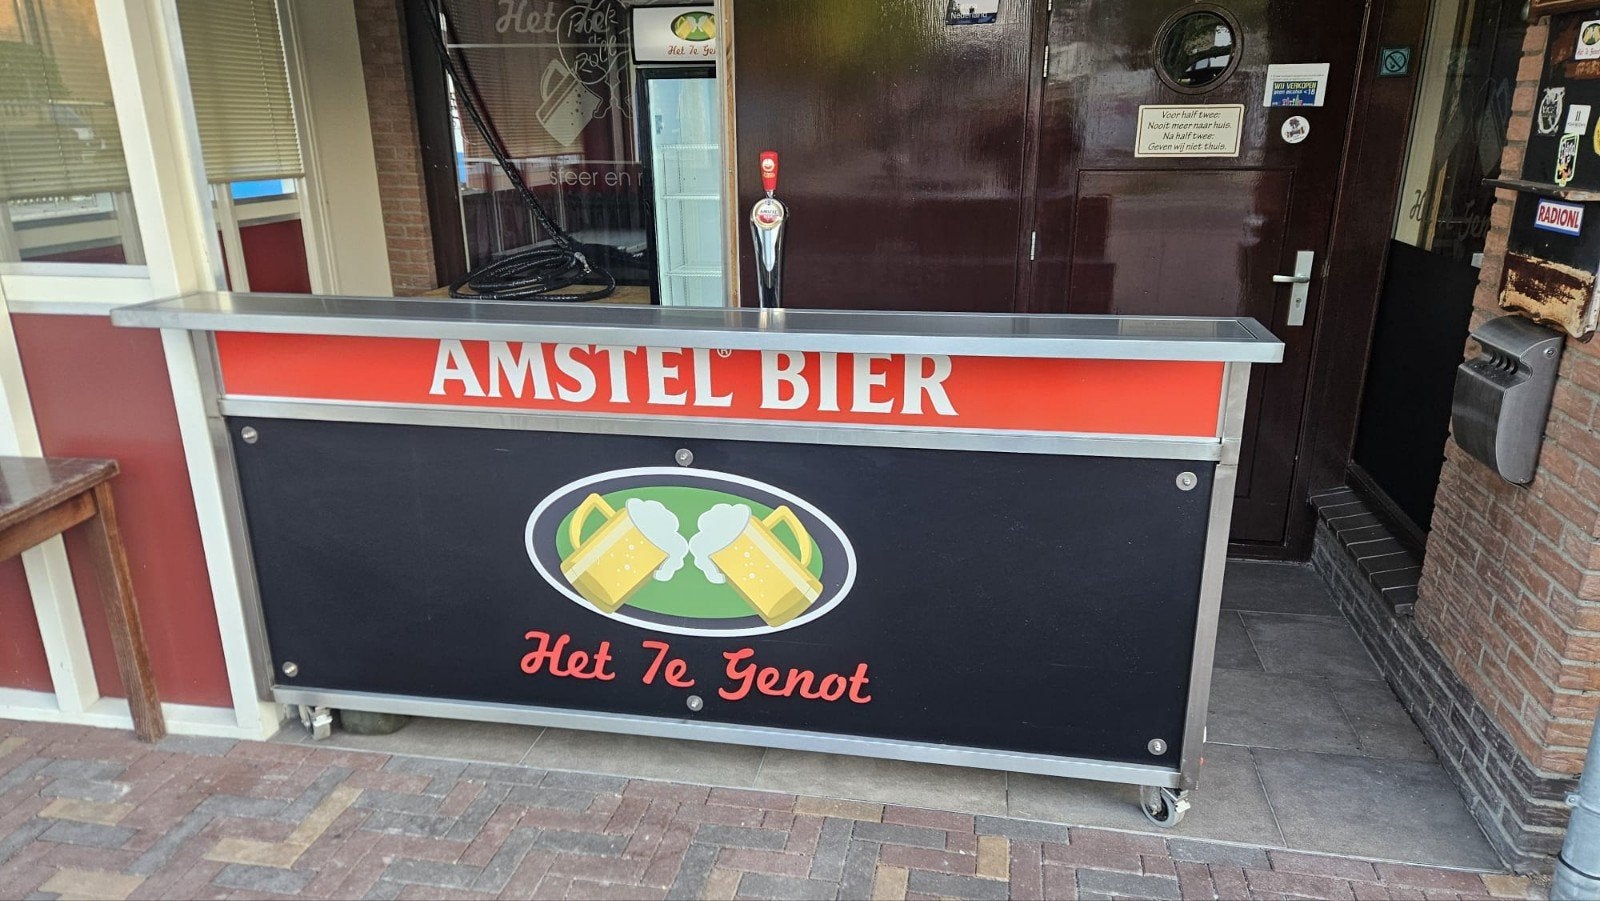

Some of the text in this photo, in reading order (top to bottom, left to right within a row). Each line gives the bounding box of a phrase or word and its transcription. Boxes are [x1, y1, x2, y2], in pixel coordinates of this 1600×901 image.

[495, 0, 558, 33] Het
[667, 45, 685, 55] Het
[1162, 111, 1180, 119] Voor
[1181, 110, 1199, 119] half
[1213, 121, 1232, 129] huis.
[1162, 132, 1174, 140] Na
[1175, 132, 1193, 140] half
[1148, 142, 1172, 151] Geven
[1173, 143, 1186, 152] wij
[1203, 142, 1227, 151] thuis.
[604, 171, 631, 187] en
[760, 350, 959, 416] BIER
[520, 630, 872, 704] Het 7e Genot
